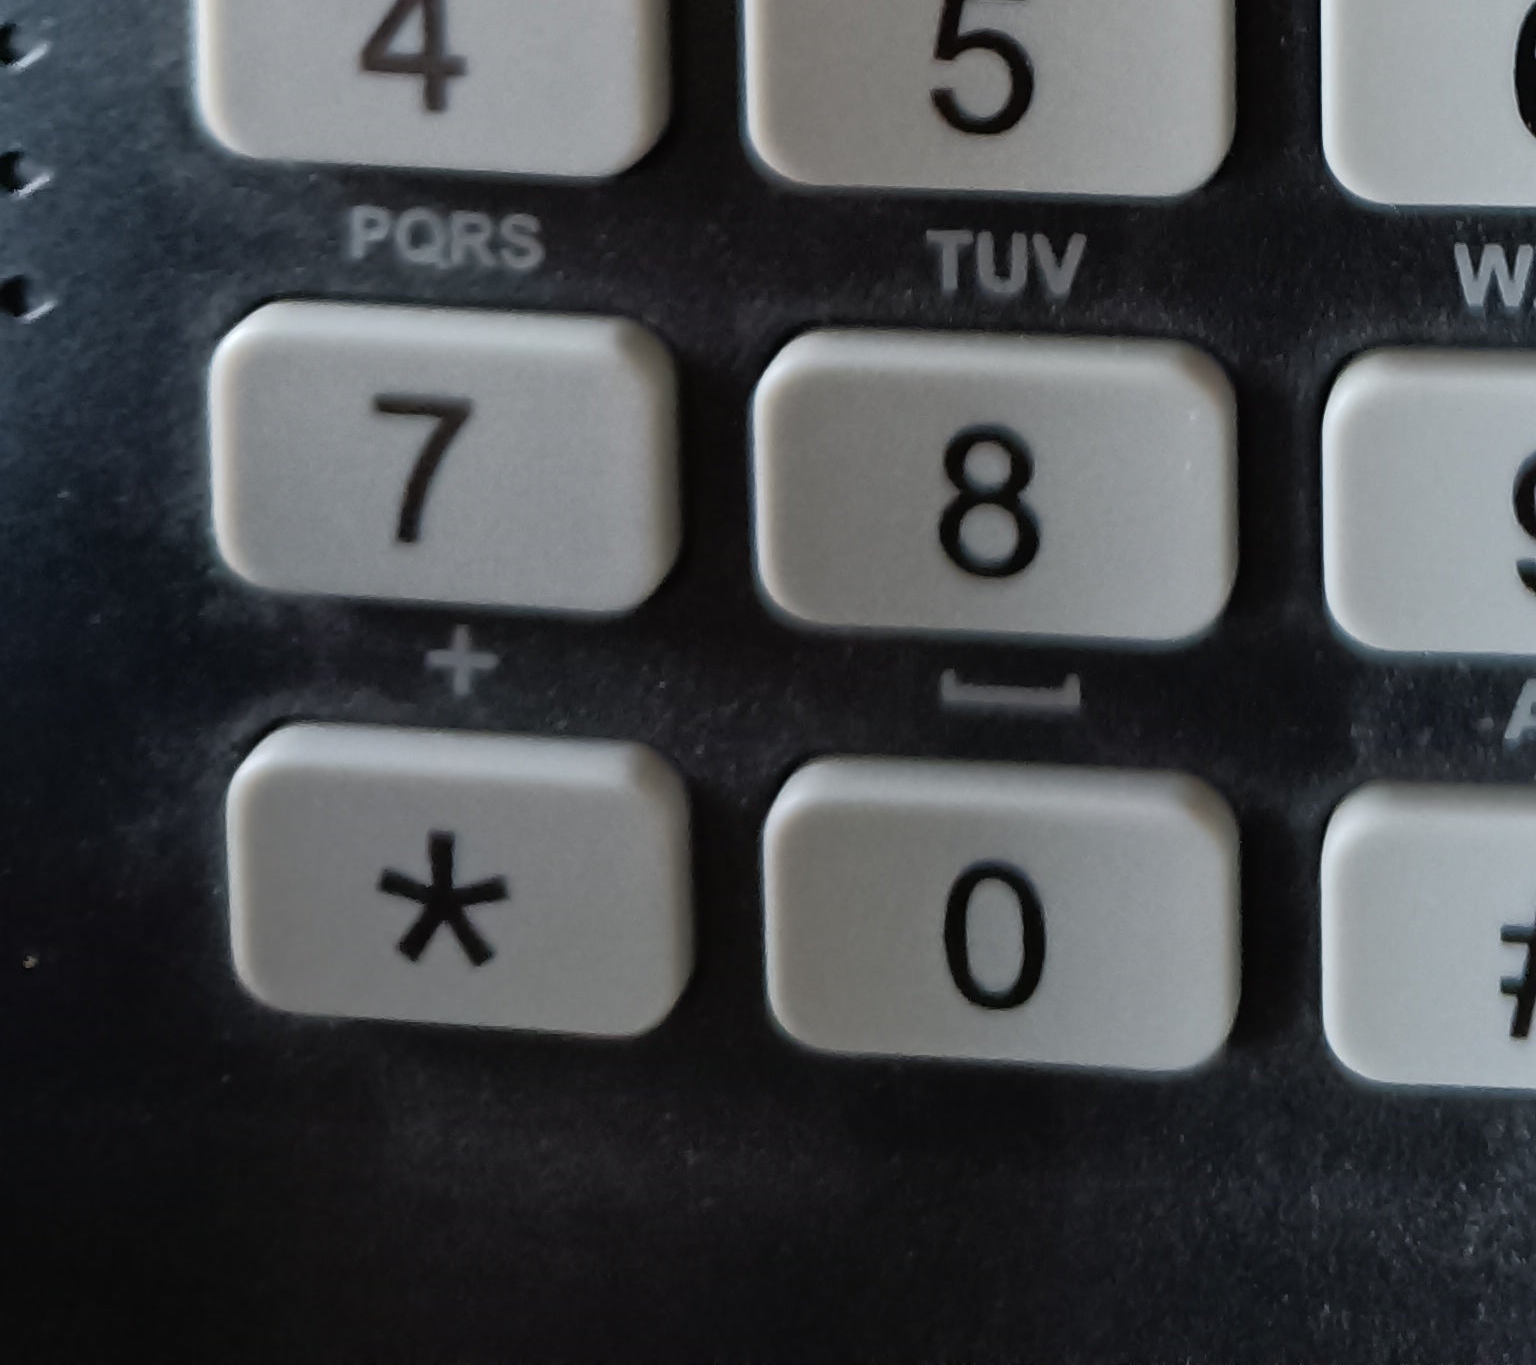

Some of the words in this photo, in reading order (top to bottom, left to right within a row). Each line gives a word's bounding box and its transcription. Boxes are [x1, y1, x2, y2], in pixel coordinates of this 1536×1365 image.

[344, 205, 543, 273] PQRS
[926, 230, 1086, 298] TUV
[374, 395, 471, 545] 7
[938, 425, 1040, 579] 8
[943, 861, 1046, 1010] 0
